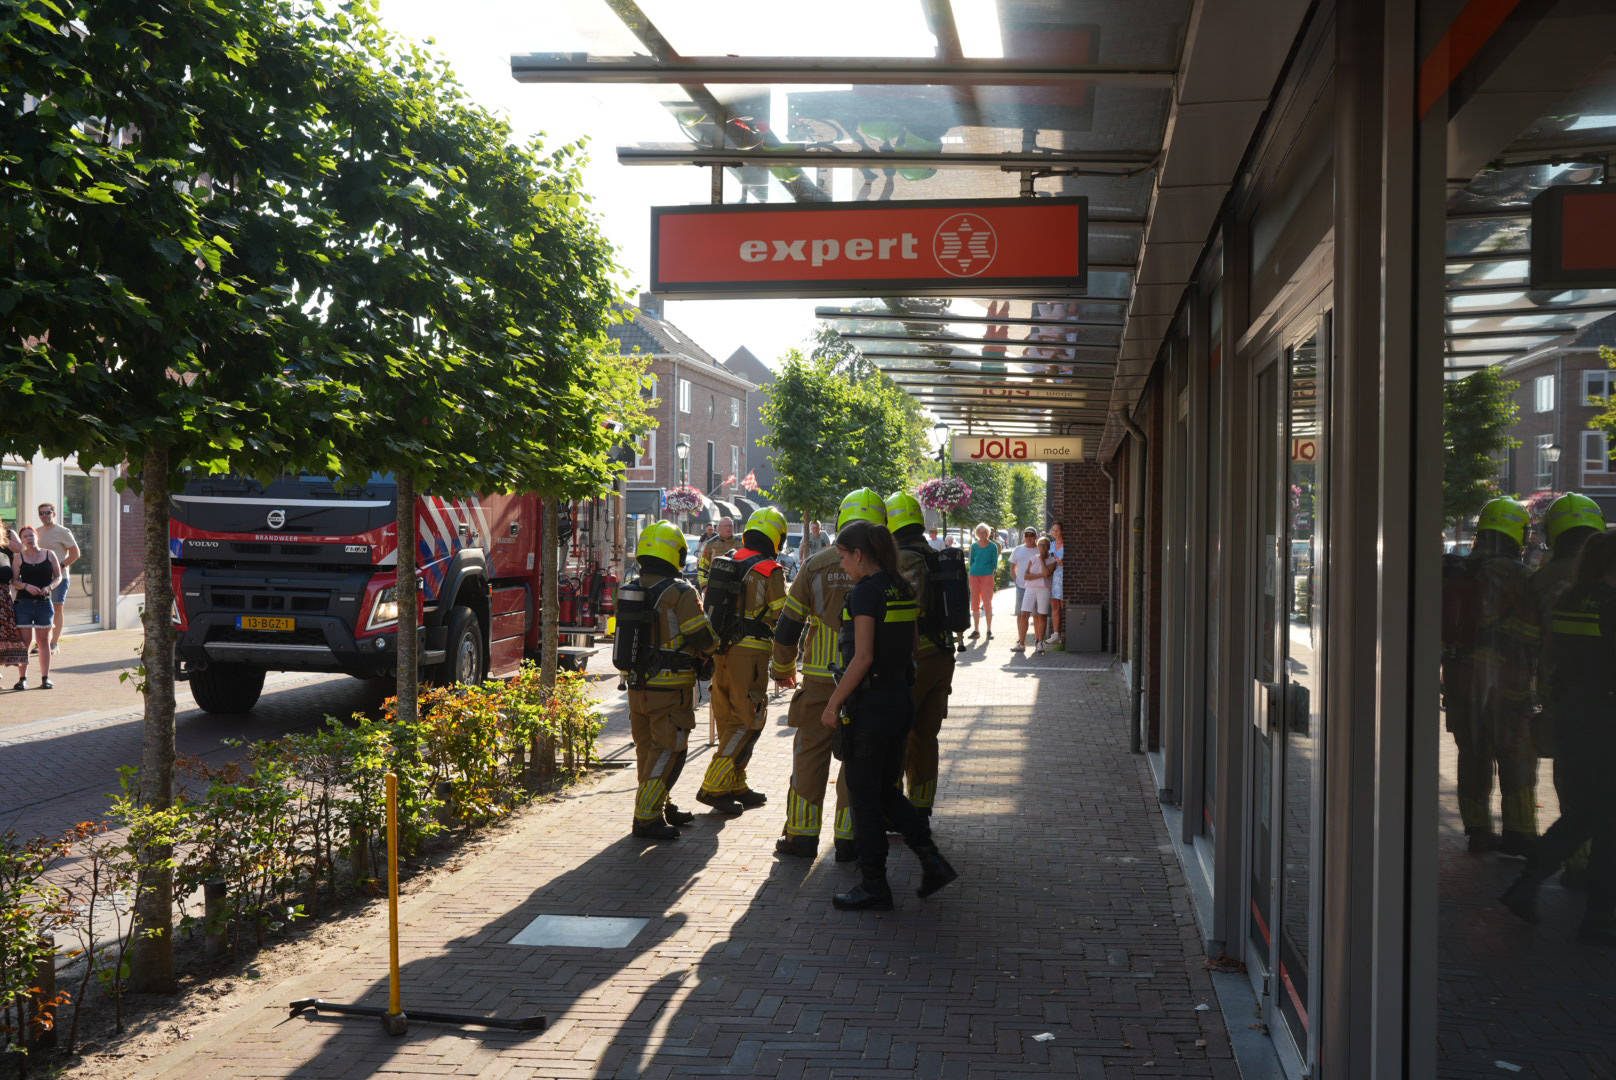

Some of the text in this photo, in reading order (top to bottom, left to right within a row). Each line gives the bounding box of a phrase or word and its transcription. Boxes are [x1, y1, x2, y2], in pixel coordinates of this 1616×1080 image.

[739, 232, 918, 267] expert
[255, 534, 298, 542] BRANDWEER
[188, 540, 219, 548] VOLVO
[248, 618, 289, 629] 13-BGZ-1
